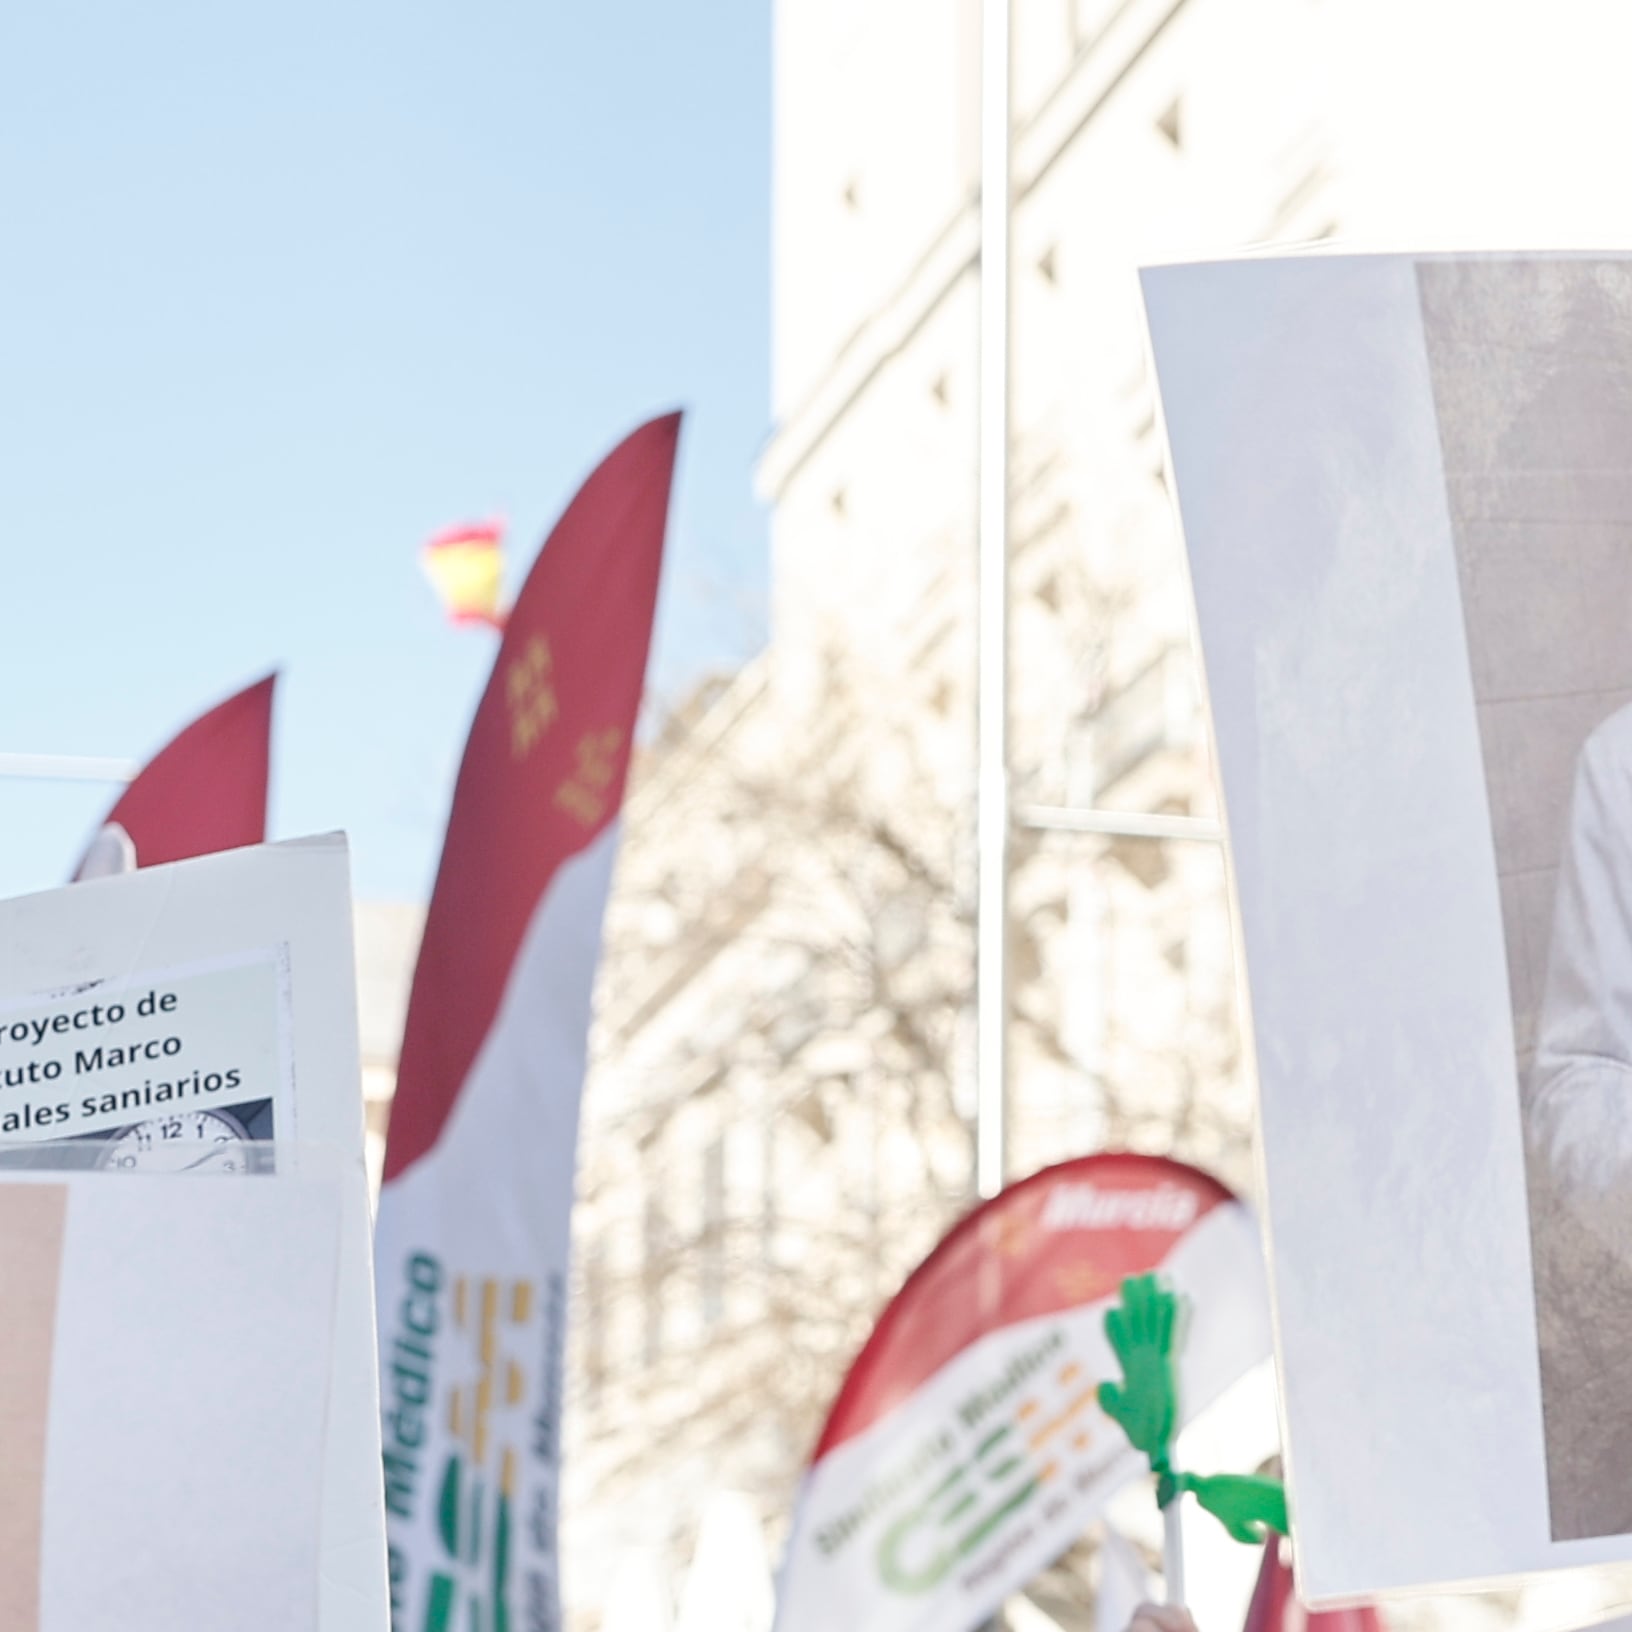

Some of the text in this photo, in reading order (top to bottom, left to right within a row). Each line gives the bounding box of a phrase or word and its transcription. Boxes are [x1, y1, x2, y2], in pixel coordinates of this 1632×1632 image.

[137, 990, 177, 1018] de
[75, 1036, 182, 1074] Marco
[81, 1068, 241, 1118] saniarios
